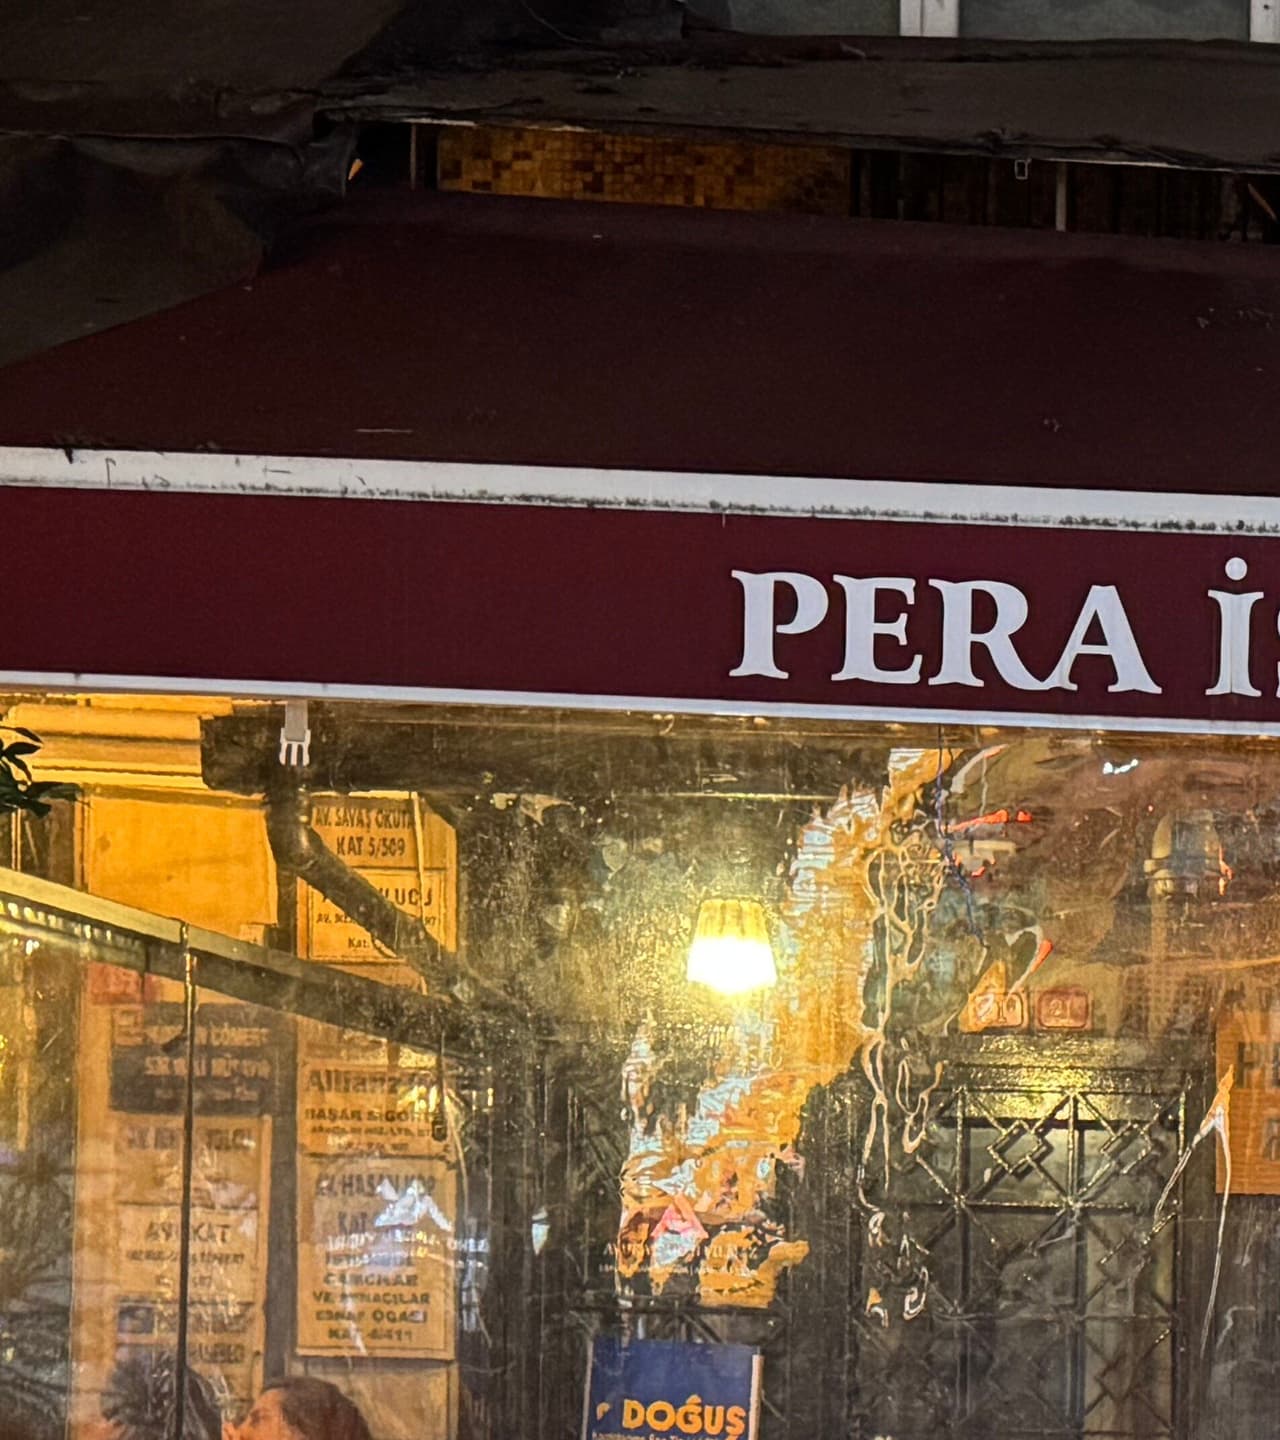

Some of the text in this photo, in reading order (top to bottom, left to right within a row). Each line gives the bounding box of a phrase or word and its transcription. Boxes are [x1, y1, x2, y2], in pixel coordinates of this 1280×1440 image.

[729, 569, 1162, 694] PERA
[375, 811, 425, 829] OKUTA
[336, 836, 363, 856] KAT
[306, 1069, 402, 1095] Allianz
[146, 1222, 231, 1244] AVKAT
